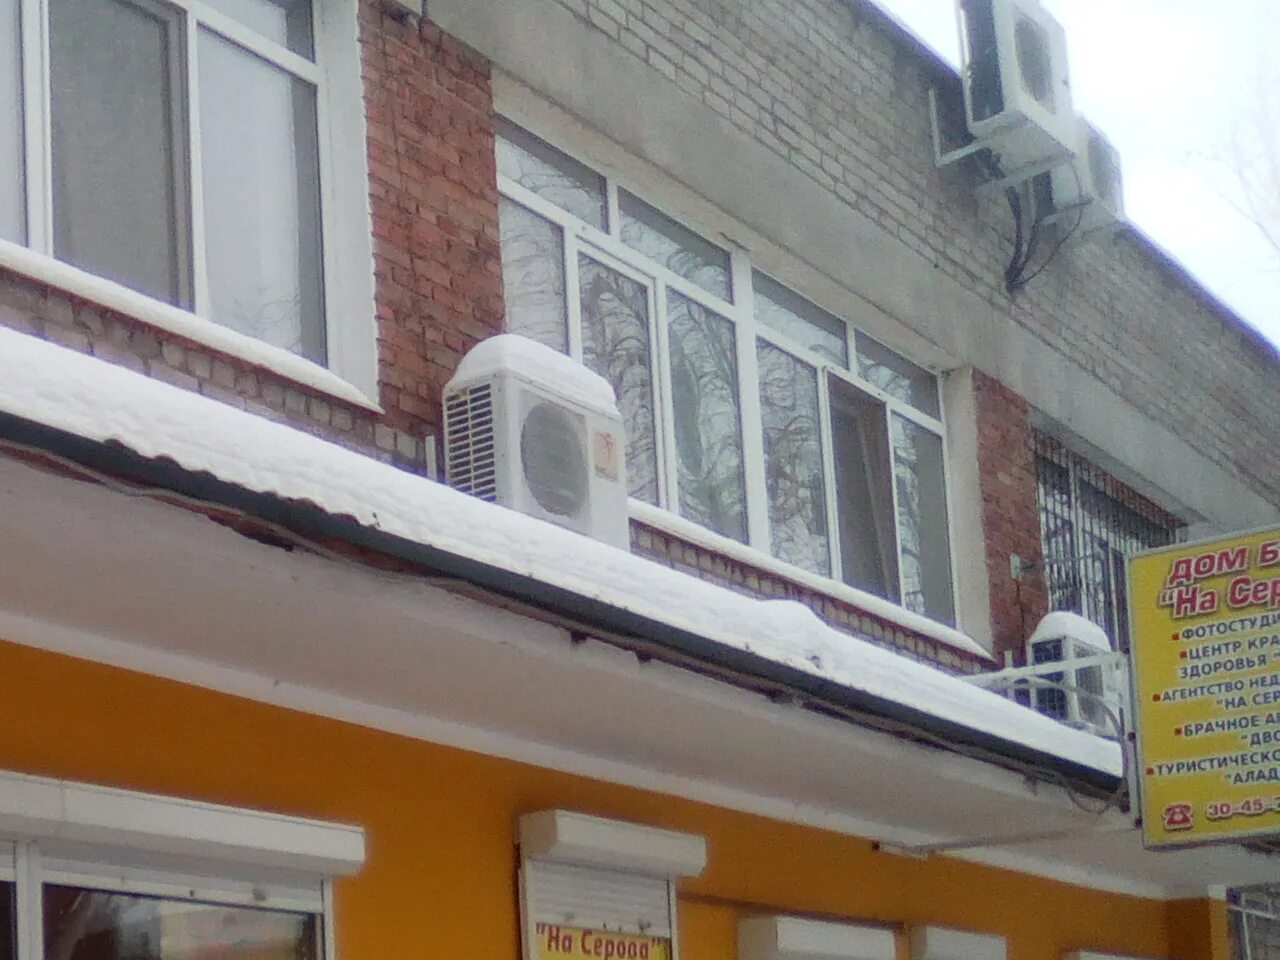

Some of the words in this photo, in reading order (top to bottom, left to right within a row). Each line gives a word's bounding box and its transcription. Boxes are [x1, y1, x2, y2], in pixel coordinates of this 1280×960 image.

[1167, 547, 1247, 588] ДОМ
[1188, 640, 1242, 661] ЦЕНТР
[1179, 654, 1267, 680] ЗДОРОВЬЯ
[1162, 680, 1245, 702] АГЕНТСТВО
[1183, 715, 1260, 738] БРАЧНОЕ
